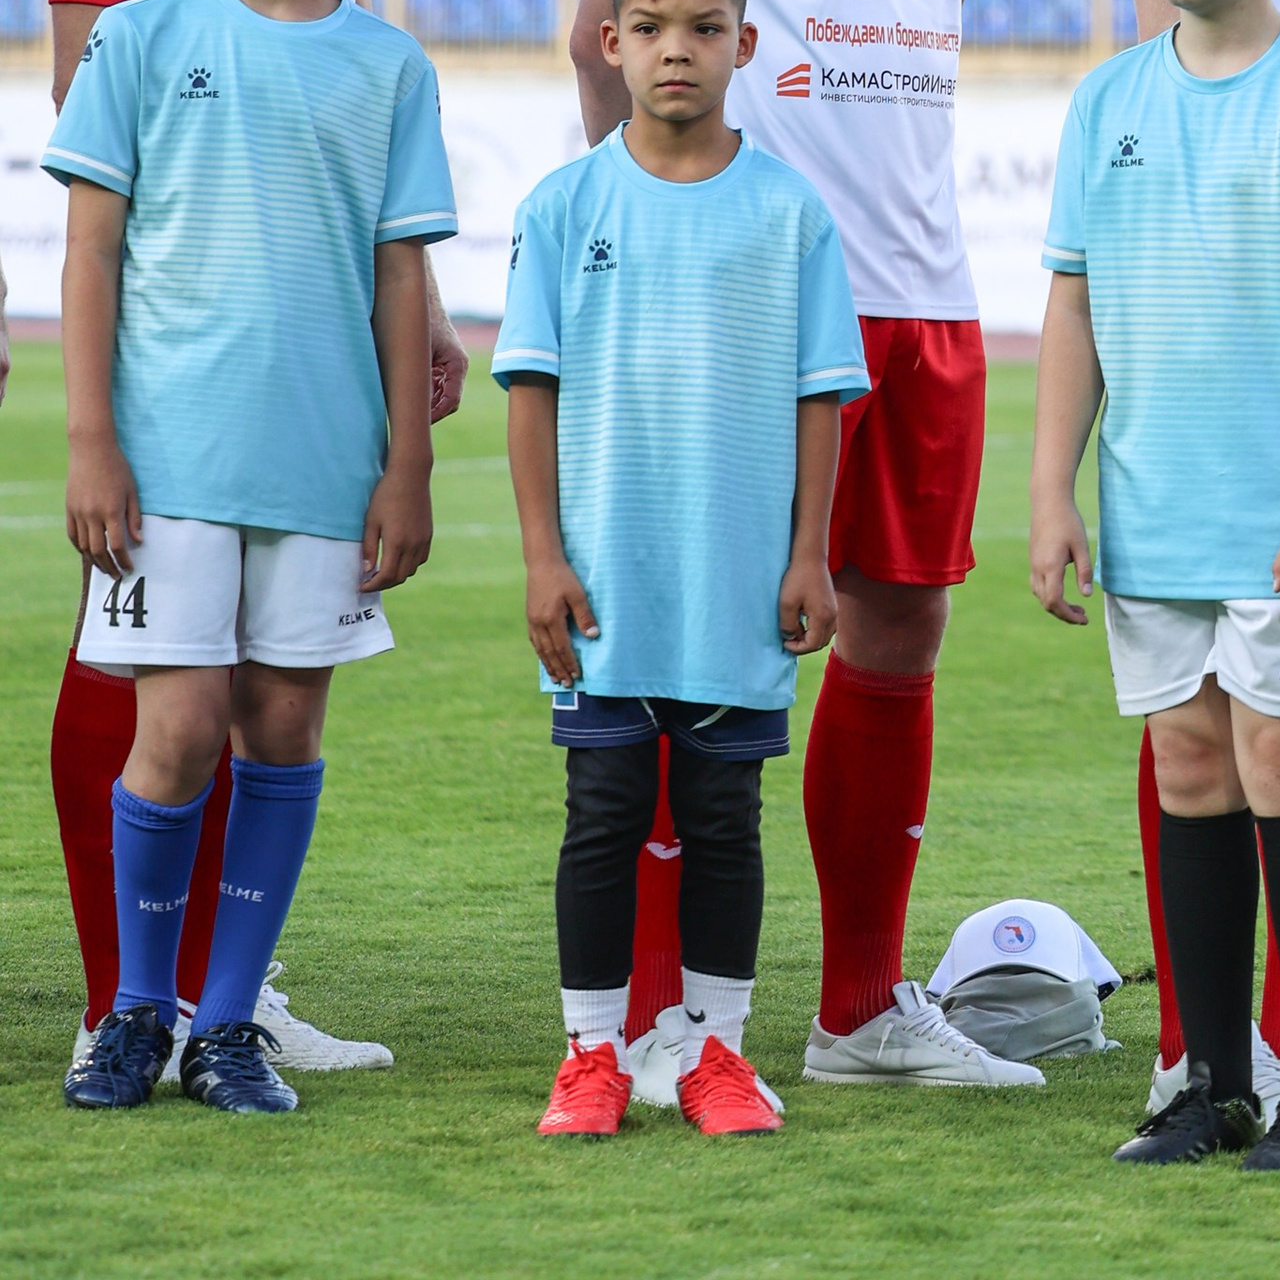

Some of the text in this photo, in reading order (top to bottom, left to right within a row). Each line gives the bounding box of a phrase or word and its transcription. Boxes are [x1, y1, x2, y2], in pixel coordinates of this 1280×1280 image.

[805, 17, 885, 47] Побеждаем
[887, 27, 894, 45] и
[896, 21, 935, 52] боремся
[180, 90, 220, 99] KELME
[1111, 158, 1145, 169] KELME
[102, 575, 148, 629] 44
[338, 608, 375, 627] KELME
[218, 881, 265, 903] ELME
